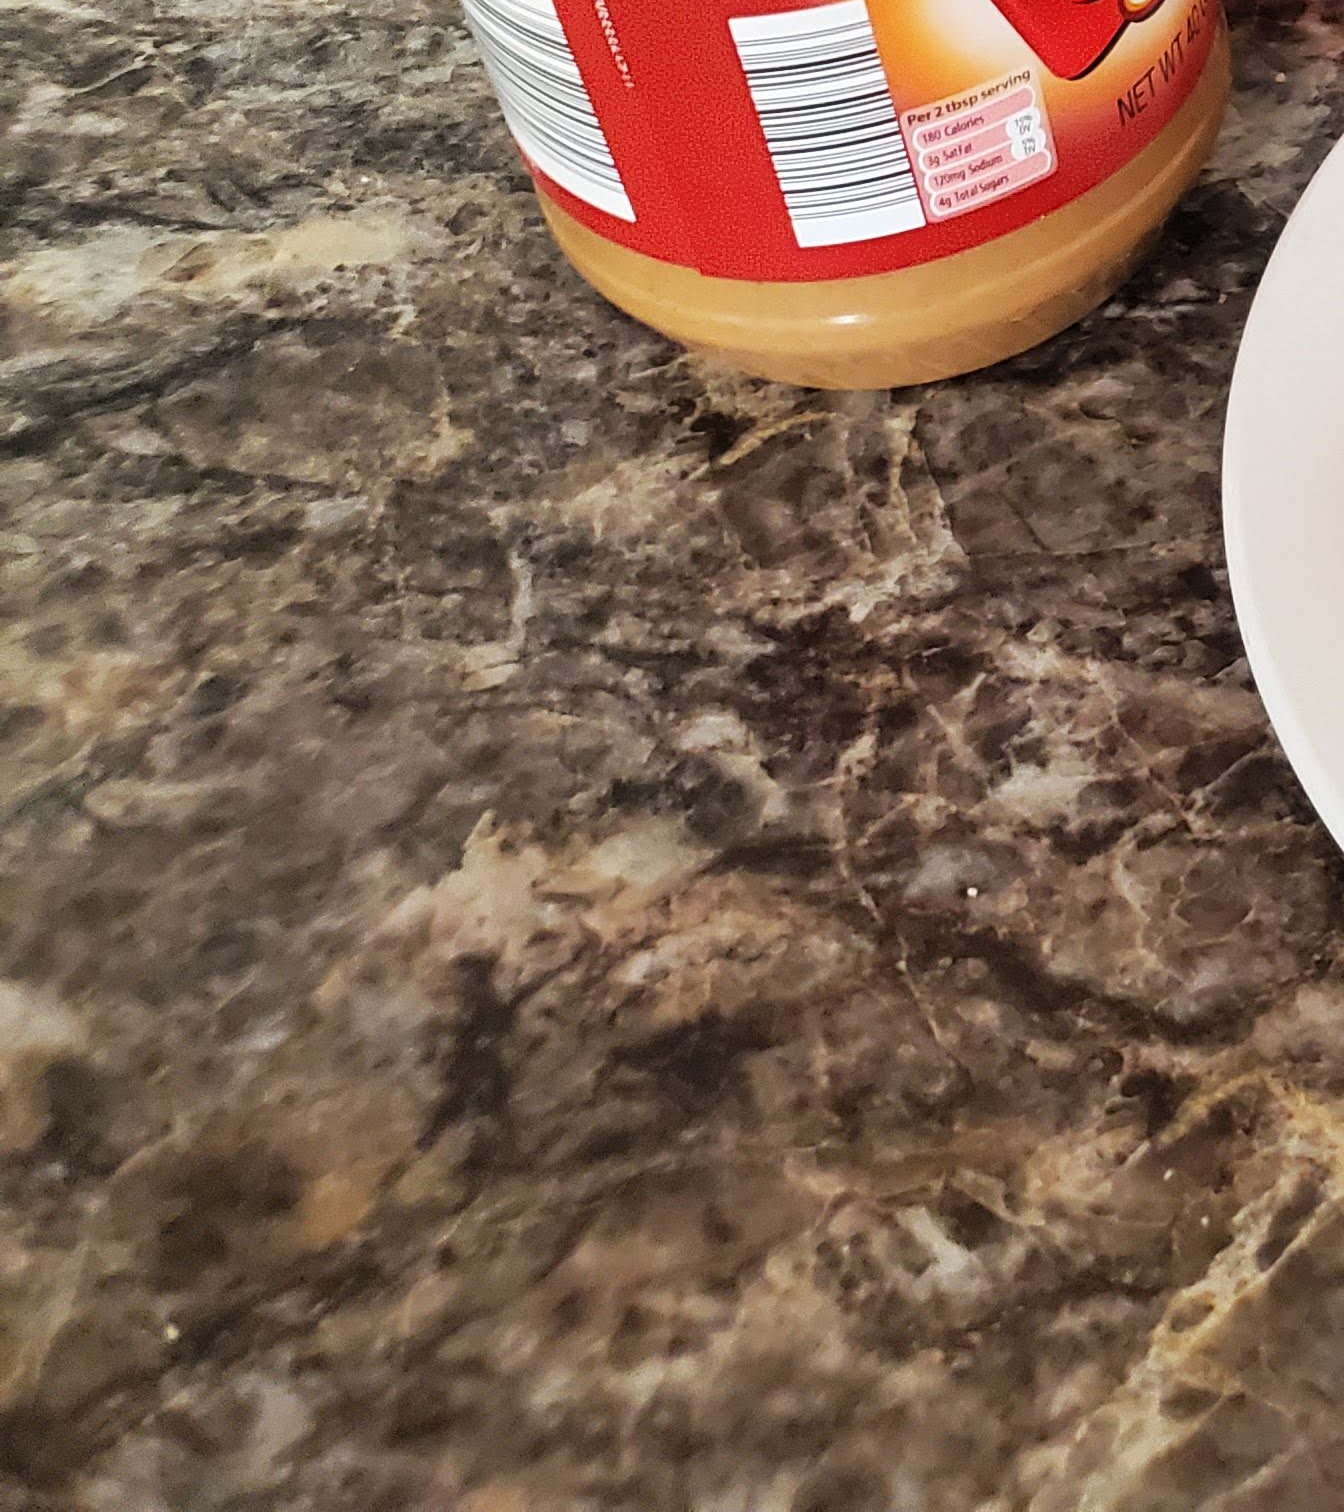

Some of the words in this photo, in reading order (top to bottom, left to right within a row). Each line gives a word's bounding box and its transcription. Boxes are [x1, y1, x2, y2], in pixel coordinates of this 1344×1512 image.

[1117, 65, 1155, 127] NET
[1158, 31, 1184, 83] WT
[906, 112, 932, 127] Per
[934, 106, 945, 119] 2
[945, 94, 979, 113] tbsp
[980, 69, 1031, 99] serving
[922, 131, 941, 145] 180
[944, 115, 985, 137] Calories
[968, 154, 1004, 175] Sodium
[939, 195, 951, 208] 4g
[955, 182, 978, 202] Total
[979, 174, 1010, 193] Sugars
